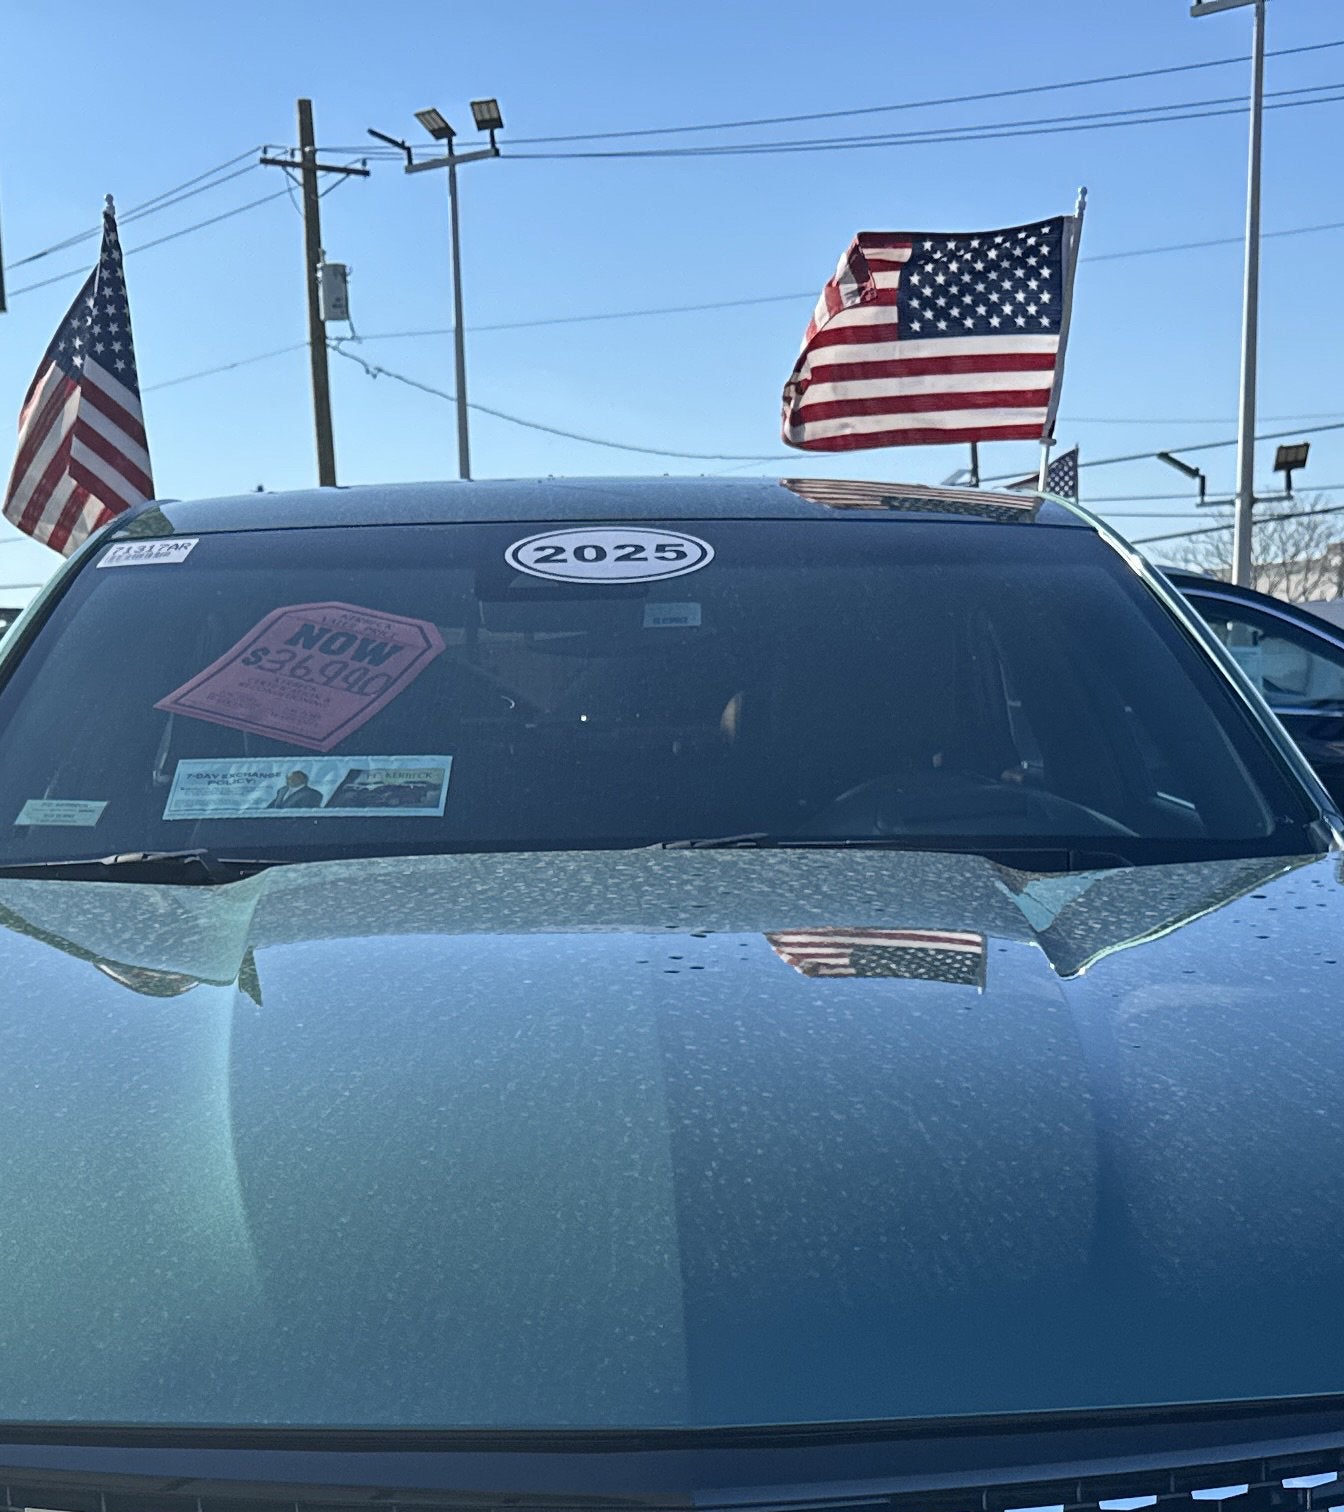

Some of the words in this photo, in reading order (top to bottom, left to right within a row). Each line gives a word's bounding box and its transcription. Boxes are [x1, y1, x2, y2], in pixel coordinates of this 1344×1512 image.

[533, 543, 688, 564] 2025
[284, 623, 405, 667] NOW
[186, 772, 223, 780] 7-DAY
